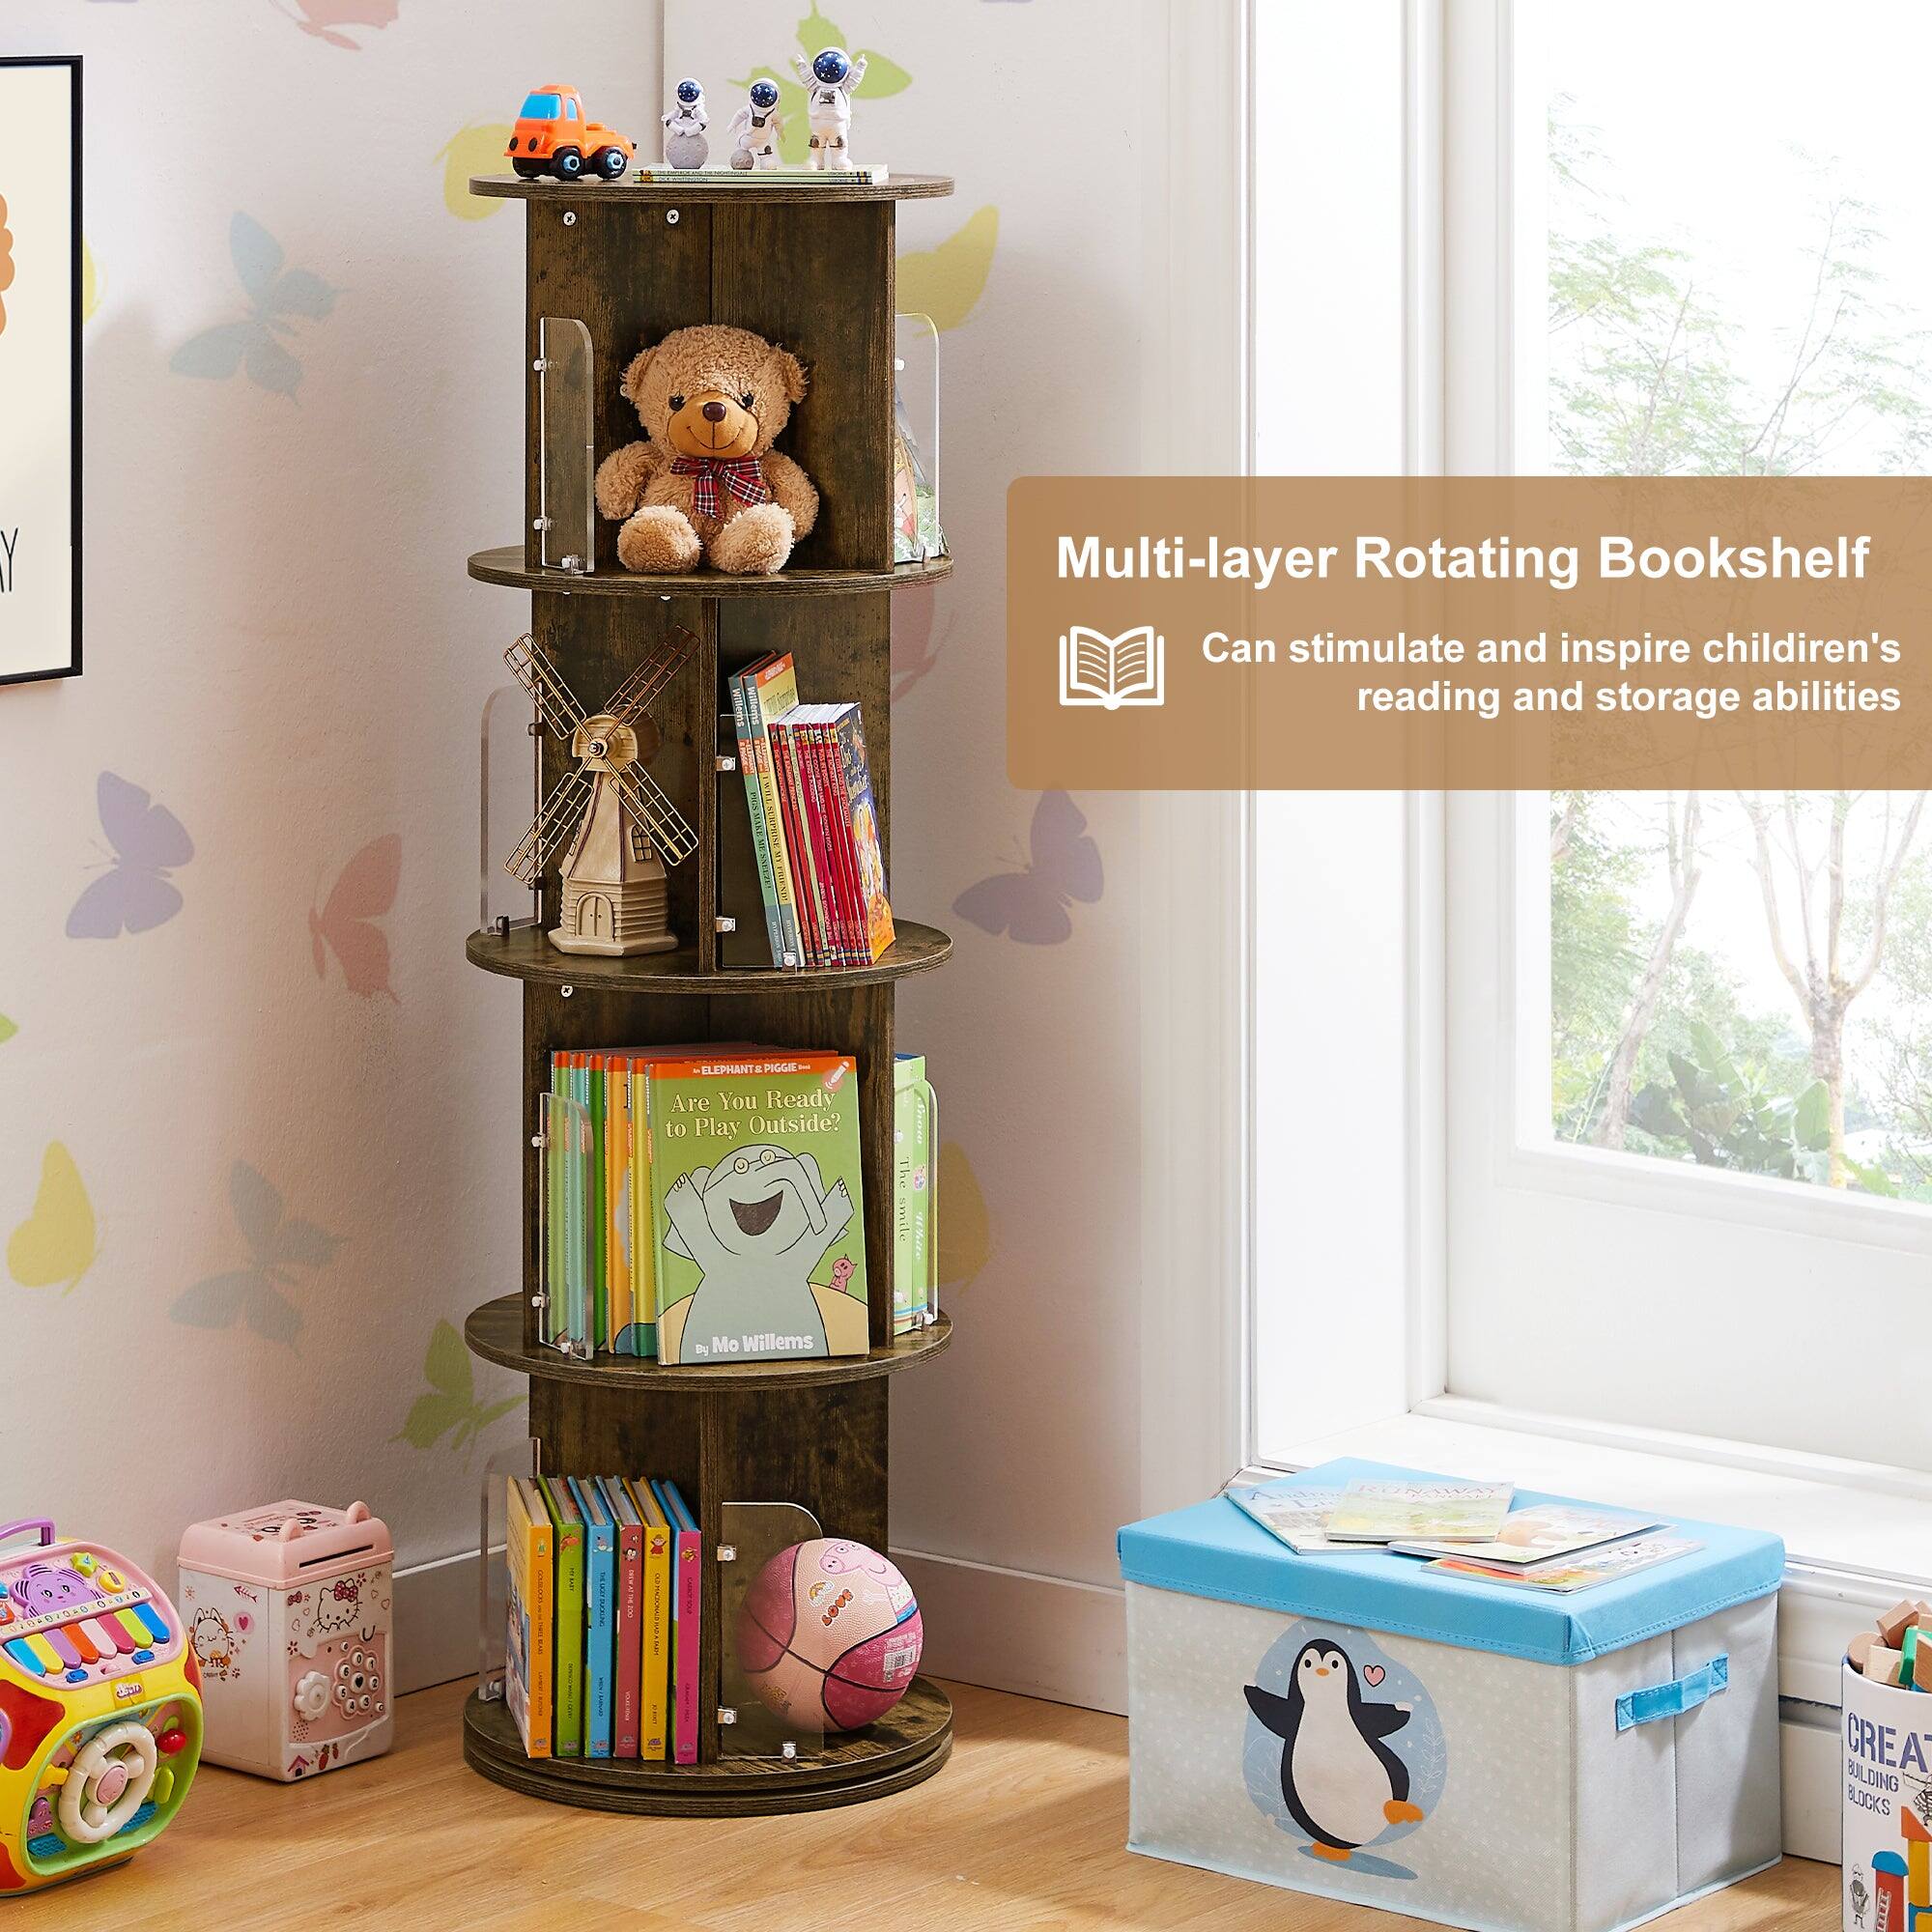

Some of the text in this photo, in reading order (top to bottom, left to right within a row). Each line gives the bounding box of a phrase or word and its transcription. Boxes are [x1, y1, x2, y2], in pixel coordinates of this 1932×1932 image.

[0, 527, 18, 593] Y
[731, 687, 746, 726] Willems
[746, 686, 761, 725] Willems
[761, 781, 773, 805] WILL
[765, 806, 780, 846] SURPRISE
[749, 791, 772, 889] PIGS MAKE ME SNEEZE!
[773, 847, 782, 864] MY
[776, 866, 789, 901] FRIEND!
[701, 1065, 753, 1075] ELEPHANT
[764, 1063, 797, 1073] PIGGIE
[670, 1089, 836, 1113] Are You Ready
[665, 1113, 841, 1140] to Play Outside?
[916, 1095, 925, 1144] Snow
[897, 1156, 910, 1241] The smile
[696, 1333, 814, 1356] By Mo Willems
[356, 1654, 362, 1662] 0
[370, 1660, 374, 1668] 1
[344, 1667, 349, 1677] 6
[372, 1679, 377, 1688] 2
[341, 1689, 346, 1697] 5
[363, 1697, 369, 1706] 3
[350, 1701, 355, 1710] 4
[1848, 1758, 1899, 1793] BUILDING
[1848, 1783, 1890, 1816] BLOCKS
